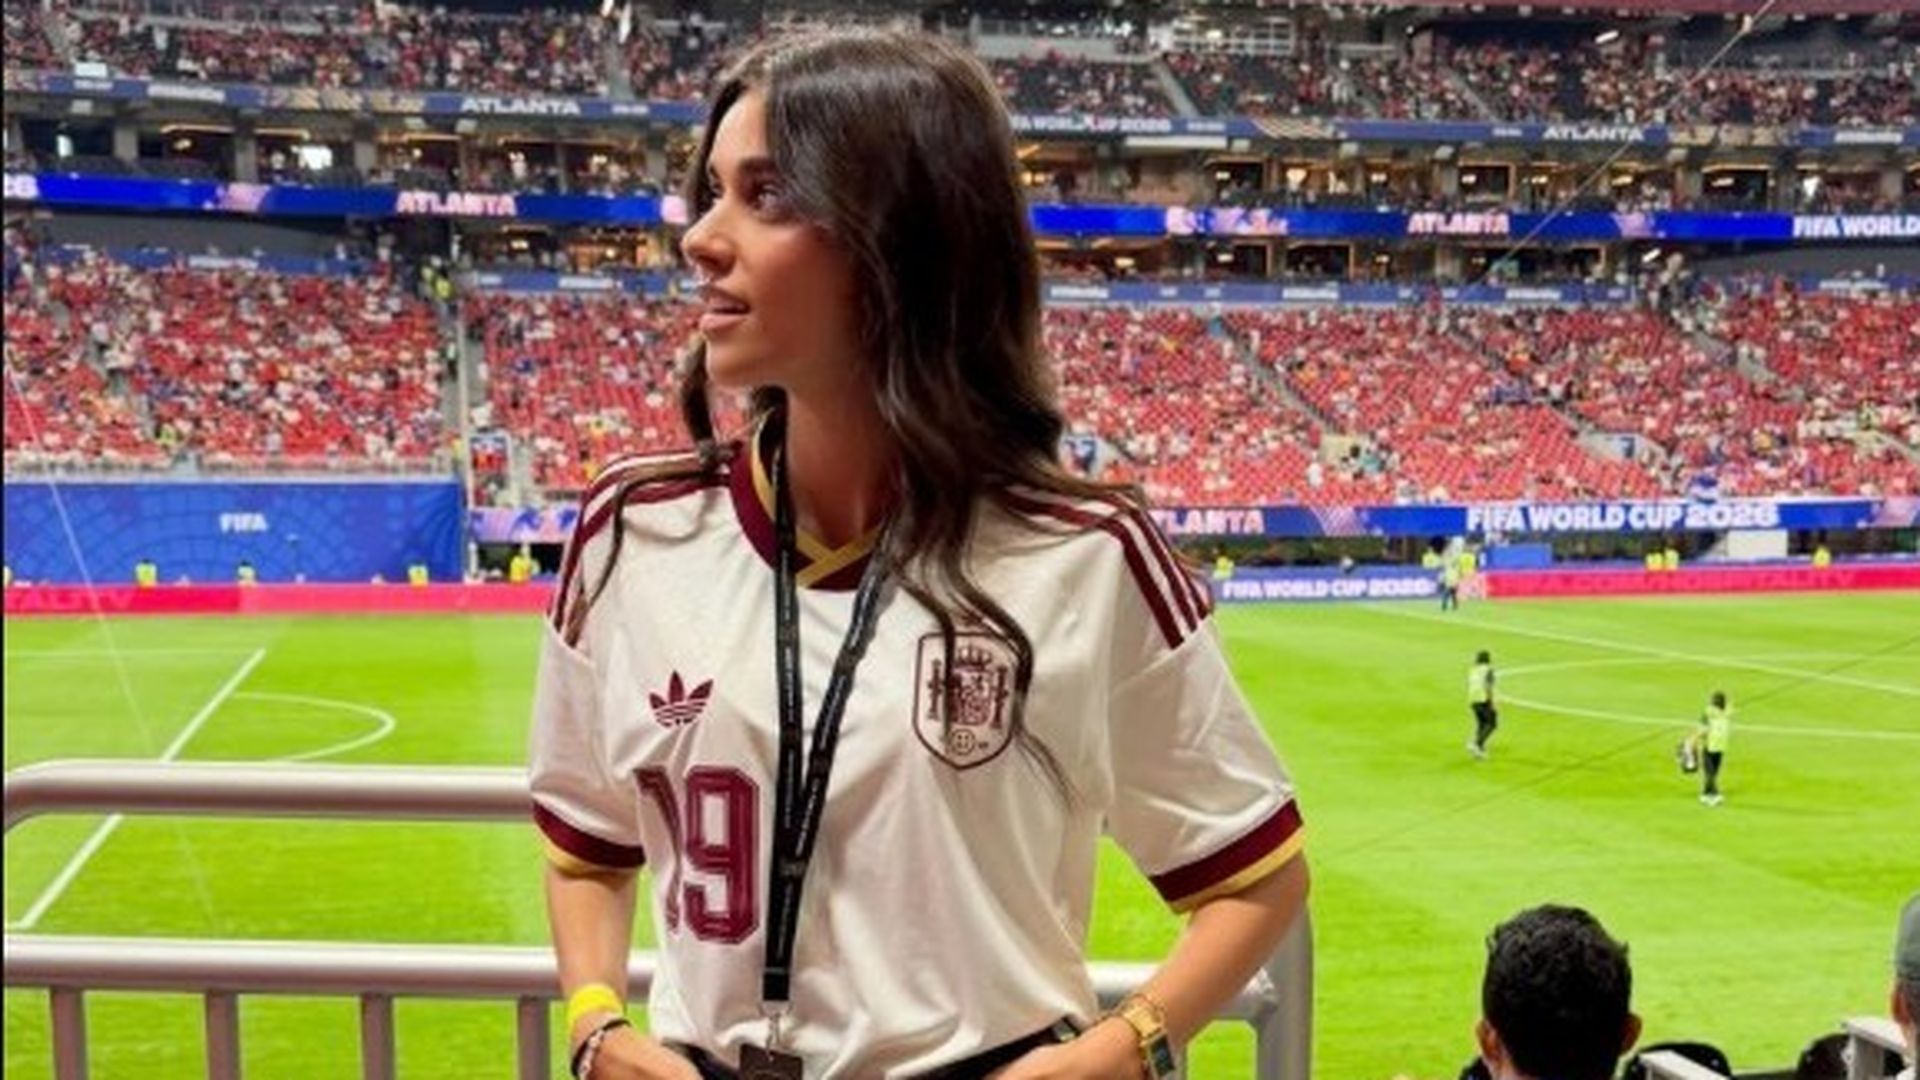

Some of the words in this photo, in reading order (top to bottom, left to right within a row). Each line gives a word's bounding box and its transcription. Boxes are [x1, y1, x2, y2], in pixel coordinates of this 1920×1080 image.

[461, 97, 580, 114] ATLANTA
[1543, 126, 1643, 142] ATLANTA
[397, 190, 517, 216] ATLANTA
[1408, 212, 1509, 234] ATLANTA
[1793, 215, 1842, 237] FIFA
[1844, 215, 1920, 237] WORLD
[219, 512, 268, 532] FIFA
[1146, 509, 1265, 535] TLANTA
[1466, 506, 1525, 531] FIFA
[1527, 505, 1625, 531] WORLD
[1628, 504, 1684, 530] CUP
[1685, 503, 1778, 529] 2026
[1222, 580, 1264, 598] FIFA
[1264, 580, 1329, 598] WORLD
[1331, 579, 1367, 597] CUP
